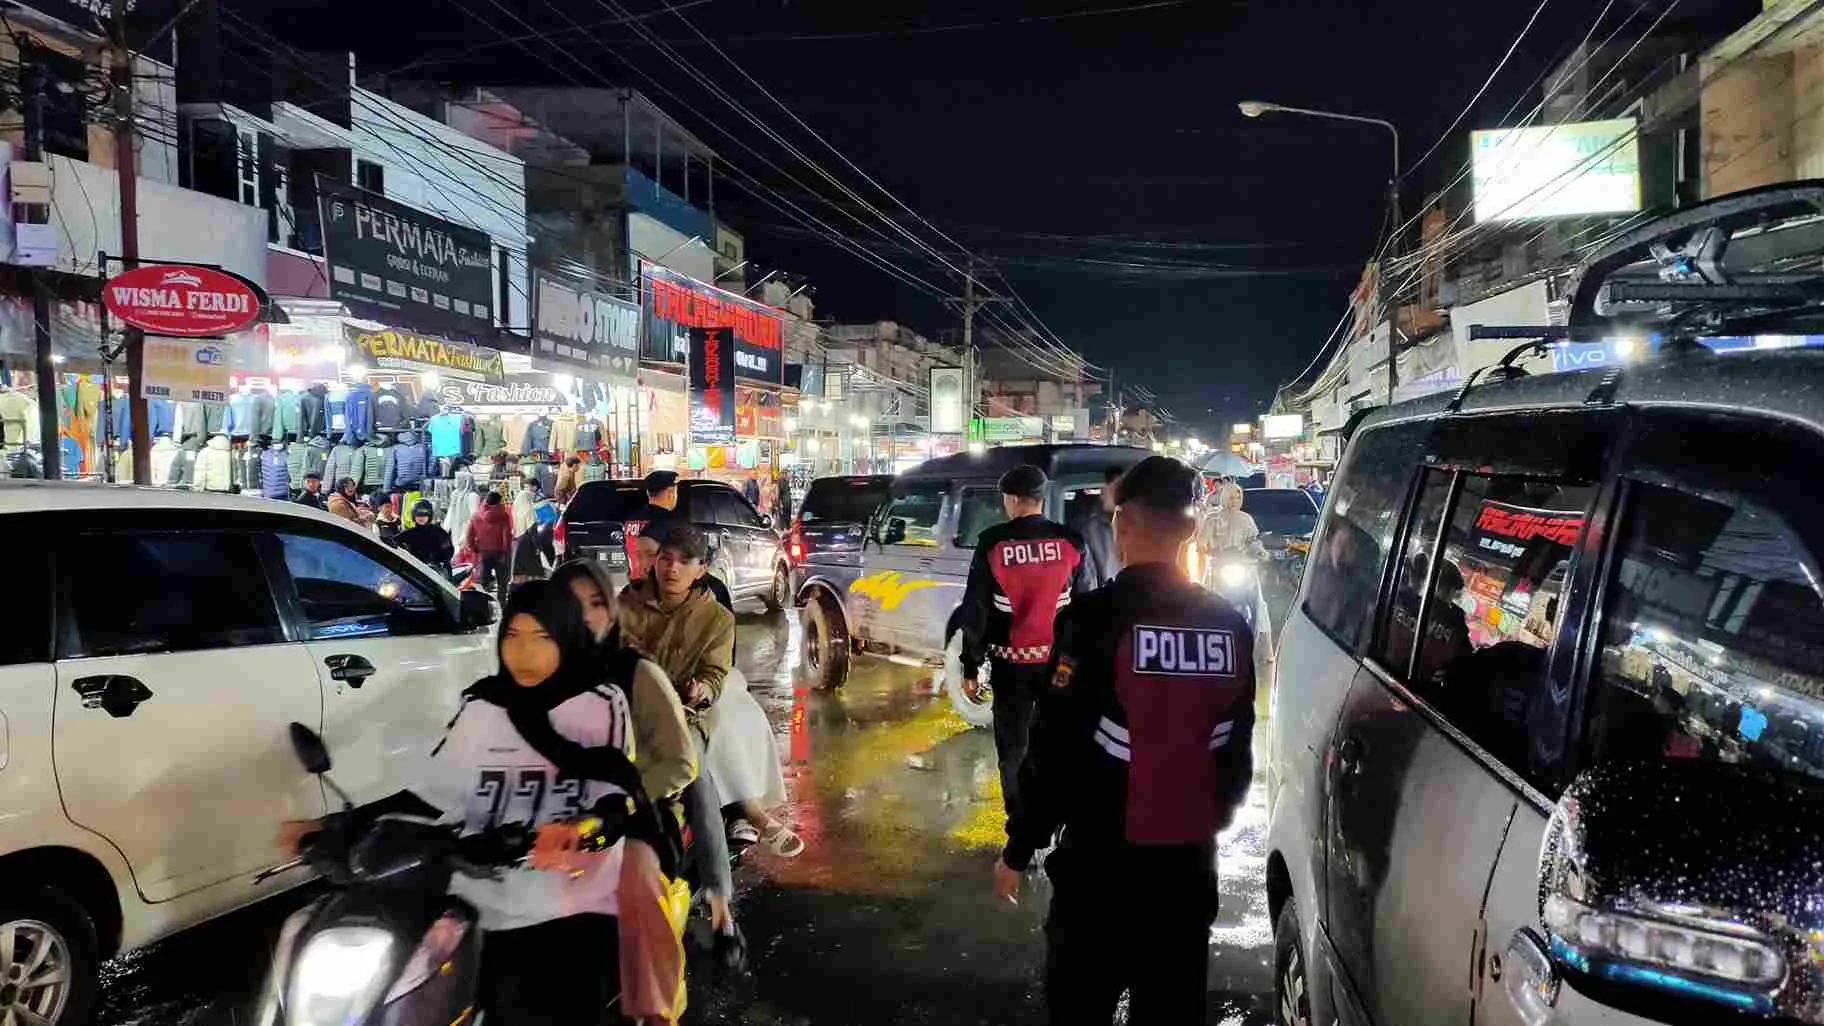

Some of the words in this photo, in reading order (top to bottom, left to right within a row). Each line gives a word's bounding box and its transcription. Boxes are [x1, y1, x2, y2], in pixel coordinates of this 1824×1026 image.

[353, 201, 459, 266] PERMATA
[112, 287, 182, 309] WISMA
[187, 291, 249, 313] FERDI
[355, 331, 450, 363] PERMATA
[1003, 542, 1062, 566] POLISI
[1138, 629, 1233, 672] POLISI
